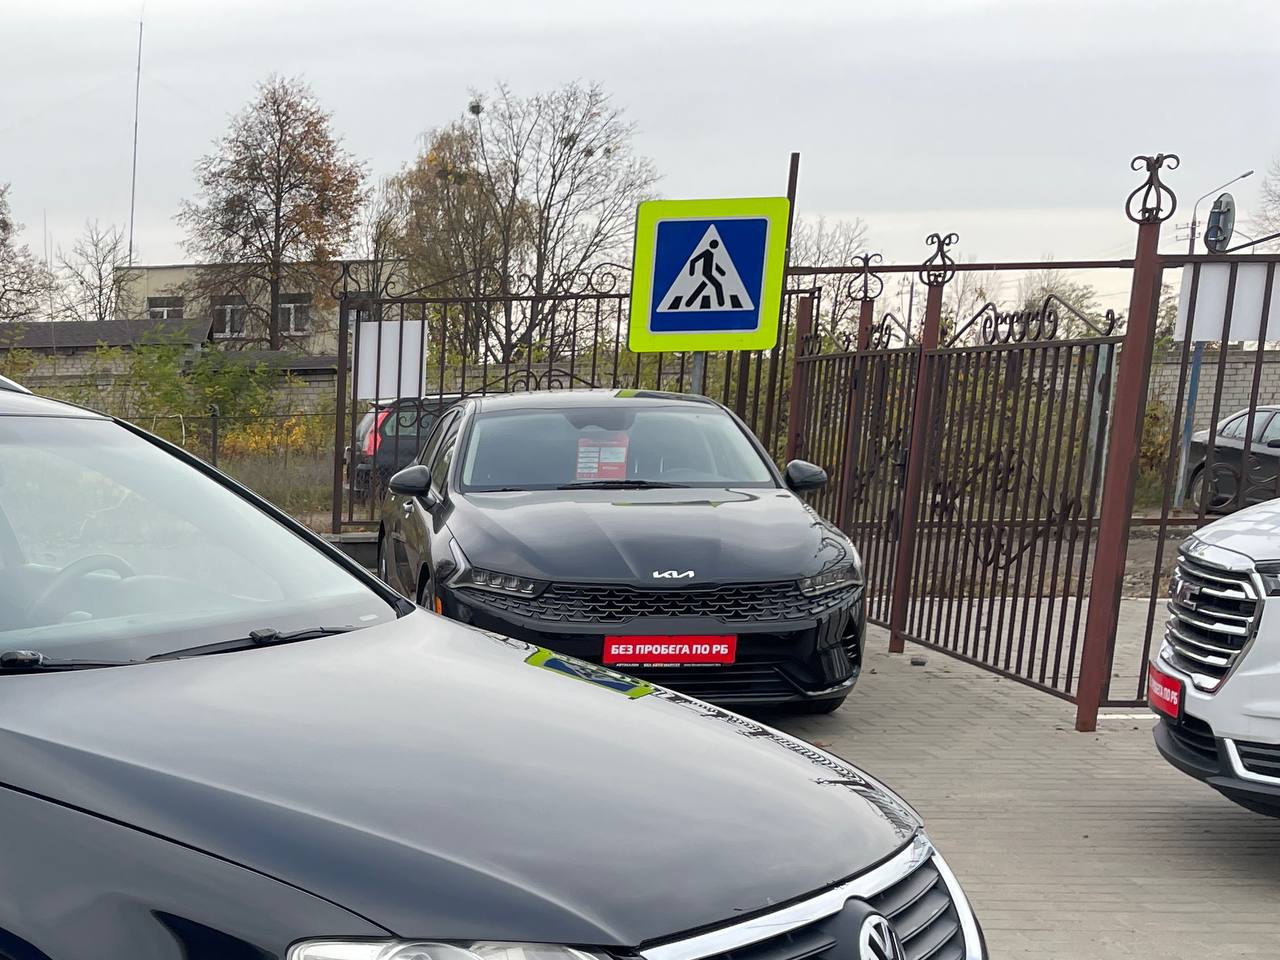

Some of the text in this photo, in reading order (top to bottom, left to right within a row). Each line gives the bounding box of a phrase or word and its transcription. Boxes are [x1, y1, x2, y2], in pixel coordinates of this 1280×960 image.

[652, 570, 695, 579] KIA
[611, 644, 729, 655] БЕЗ ПРОБЕГА ПО РБ
